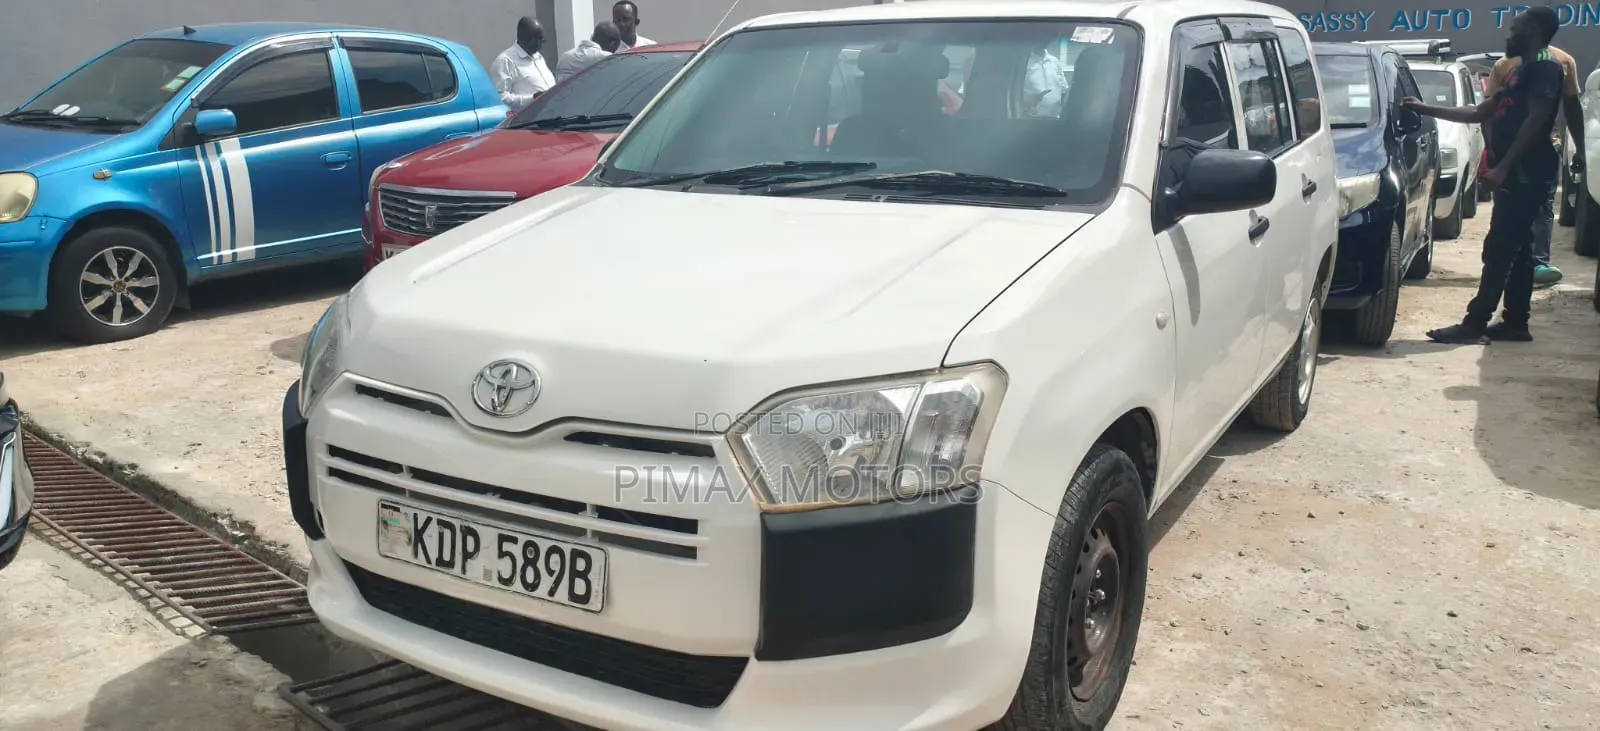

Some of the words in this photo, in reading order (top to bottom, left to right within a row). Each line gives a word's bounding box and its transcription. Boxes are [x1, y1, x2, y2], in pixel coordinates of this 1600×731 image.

[1299, 11, 1375, 32] SASSY
[1389, 8, 1472, 32] AUTO
[1489, 2, 1600, 29] TDIN
[412, 512, 481, 575] KDP
[496, 533, 593, 605] 589B
